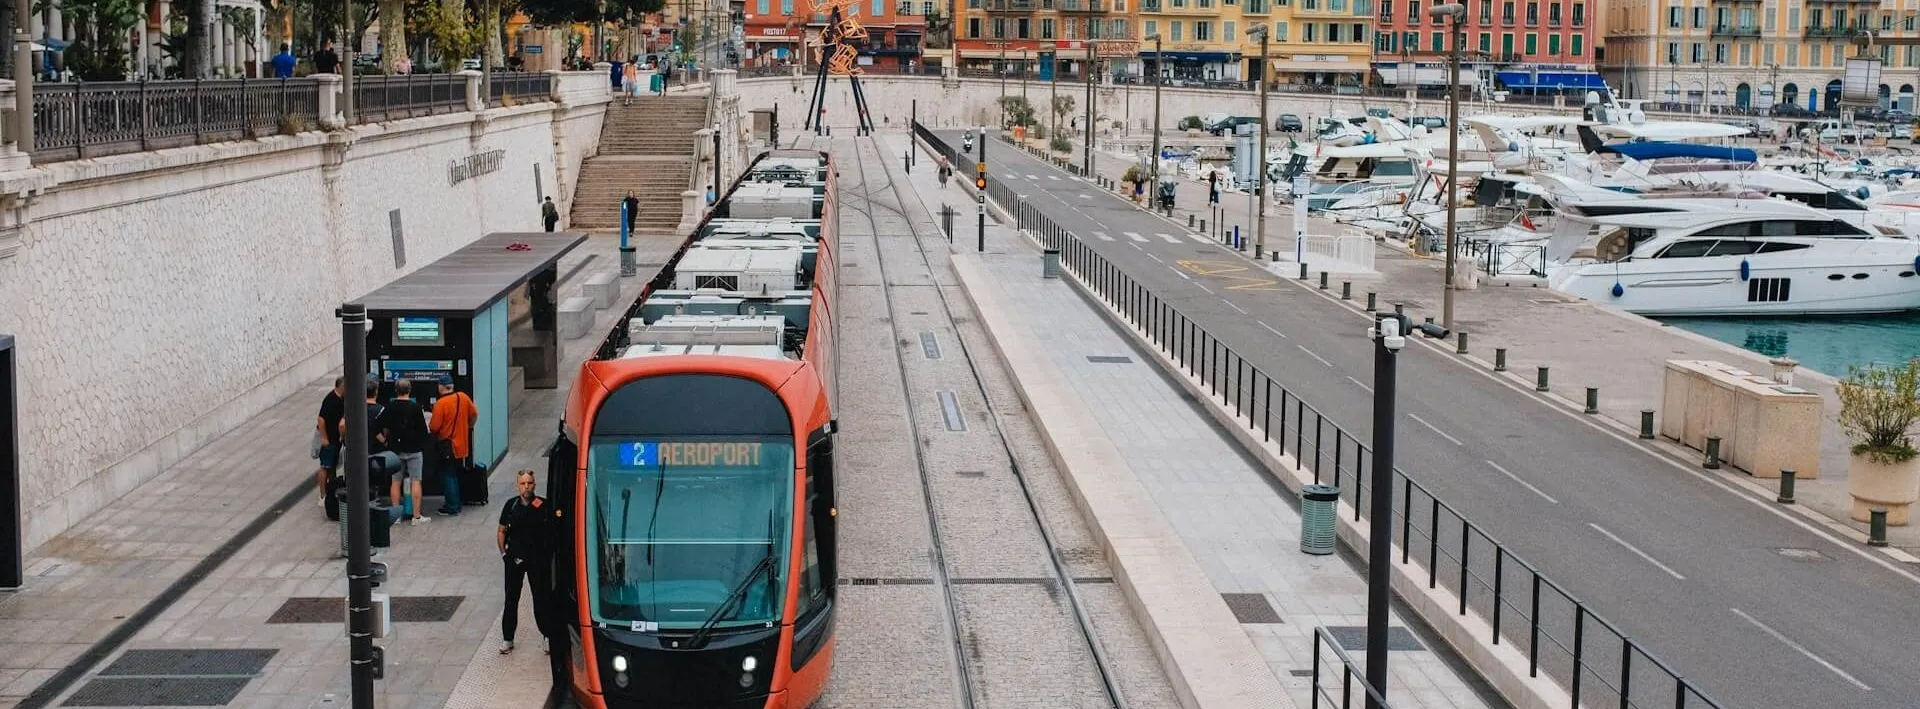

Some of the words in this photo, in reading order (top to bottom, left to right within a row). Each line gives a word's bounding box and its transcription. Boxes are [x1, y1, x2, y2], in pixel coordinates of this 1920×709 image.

[393, 372, 400, 380] 2
[633, 443, 646, 466] 2
[658, 443, 763, 466] AEROPORT
